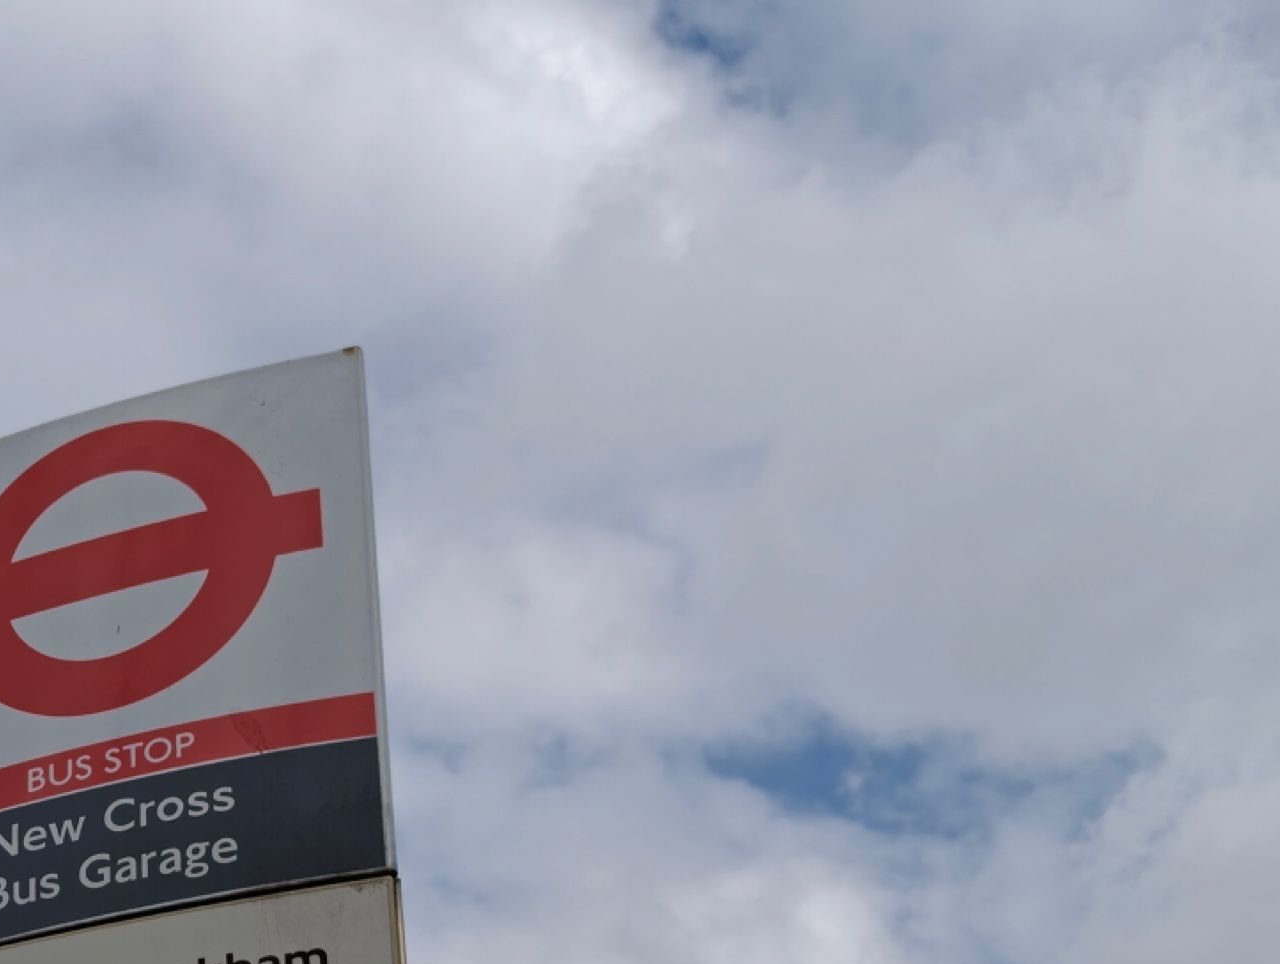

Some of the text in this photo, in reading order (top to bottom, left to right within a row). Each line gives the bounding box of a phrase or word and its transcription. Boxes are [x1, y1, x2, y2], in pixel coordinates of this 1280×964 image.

[27, 732, 195, 793] BUS STOP
[103, 785, 236, 833] Cross
[79, 836, 238, 890] Garage
